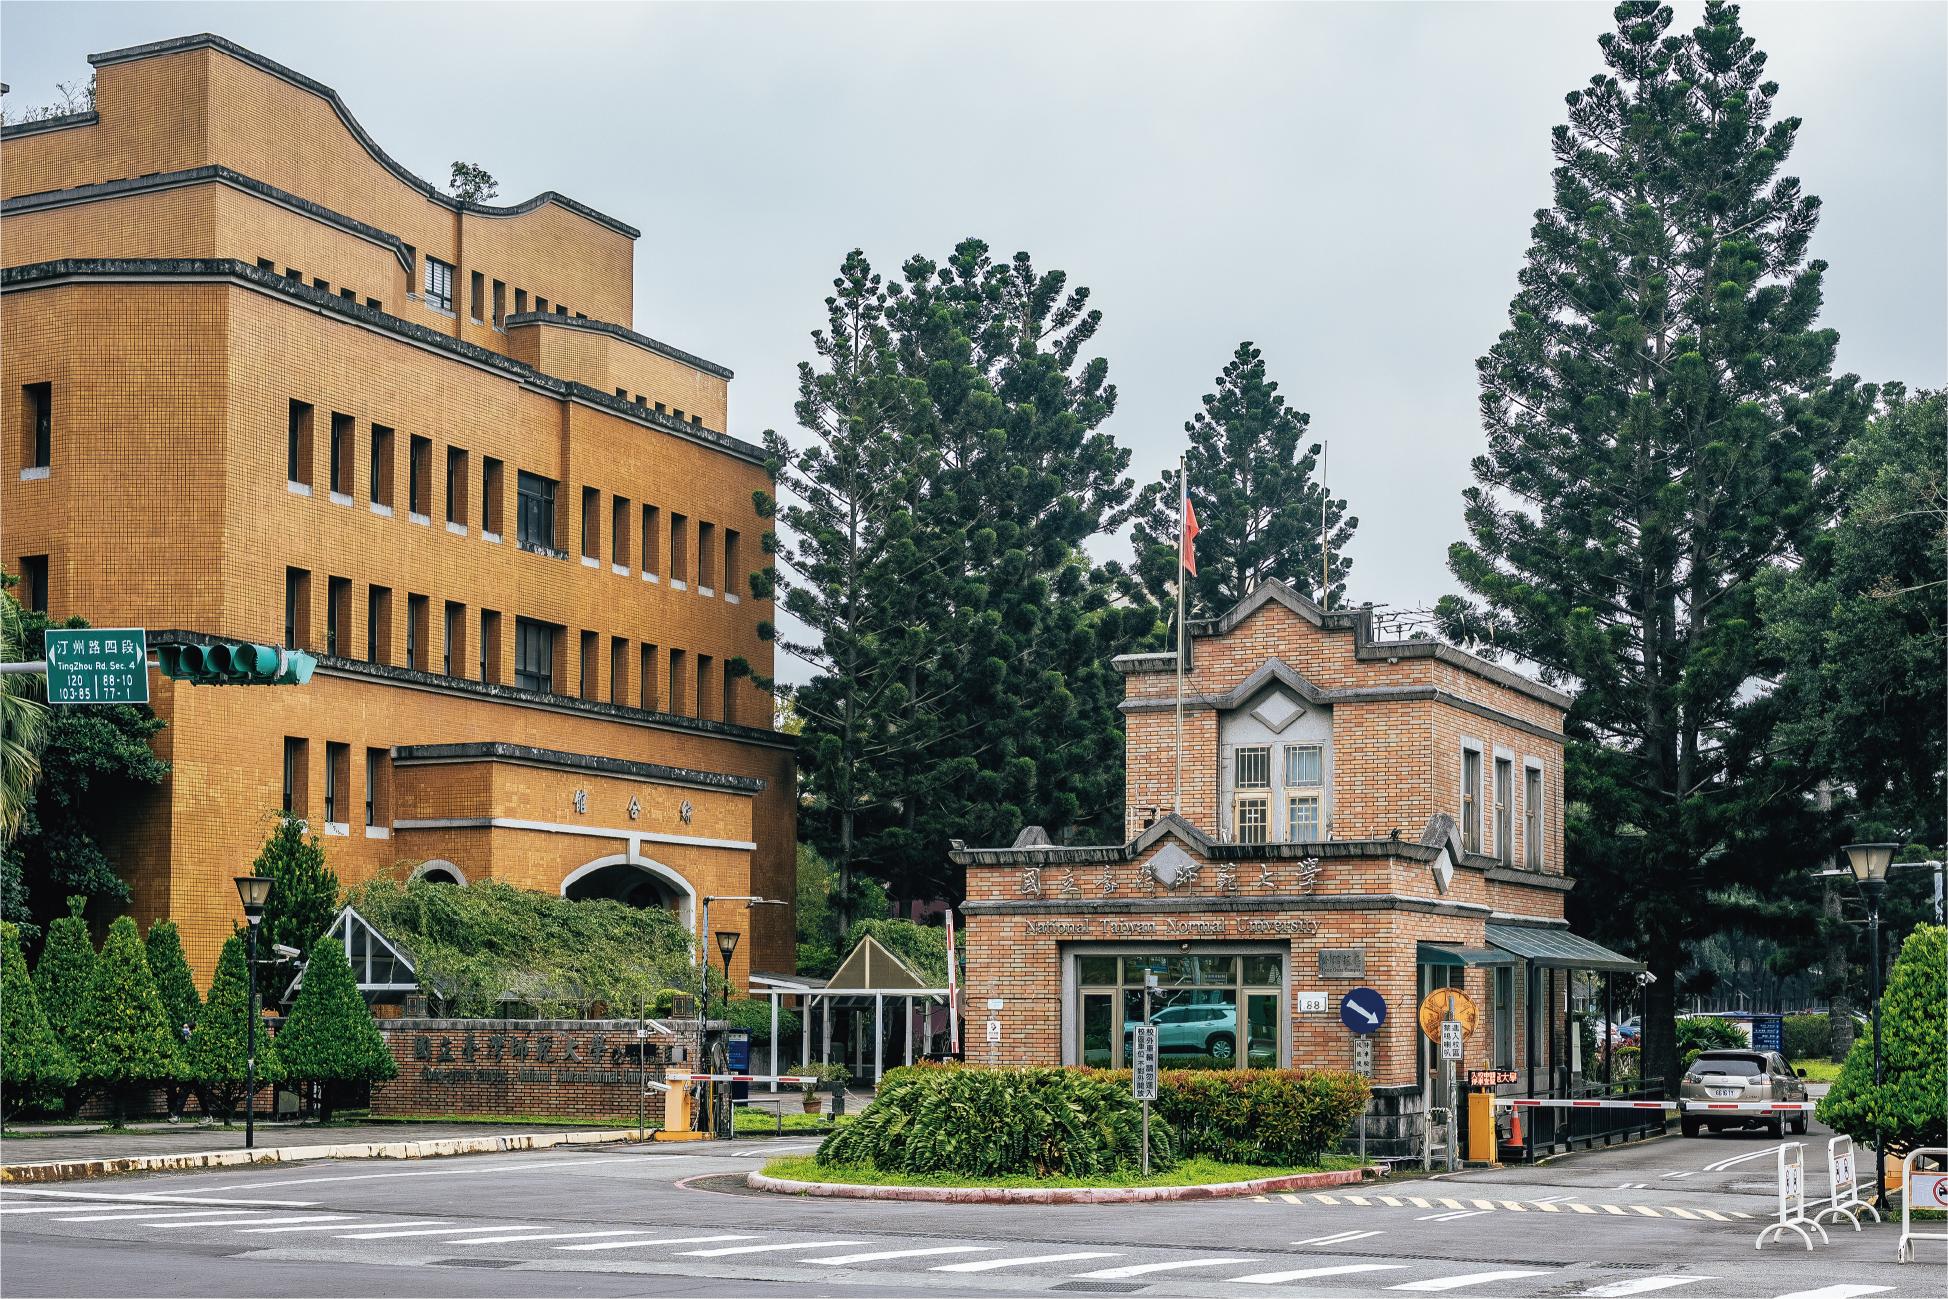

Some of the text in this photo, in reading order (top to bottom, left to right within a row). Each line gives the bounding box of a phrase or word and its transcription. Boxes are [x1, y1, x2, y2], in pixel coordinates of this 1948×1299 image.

[57, 639, 134, 655] 汀州路四段
[58, 661, 136, 672] TingZhou Rd. Sec. 4
[67, 674, 83, 686] 120
[103, 674, 133, 686] 88-10
[59, 687, 91, 699] 103-85
[1025, 917, 1322, 935] National Taiwan Normal University
[1306, 1000, 1320, 1009] 88
